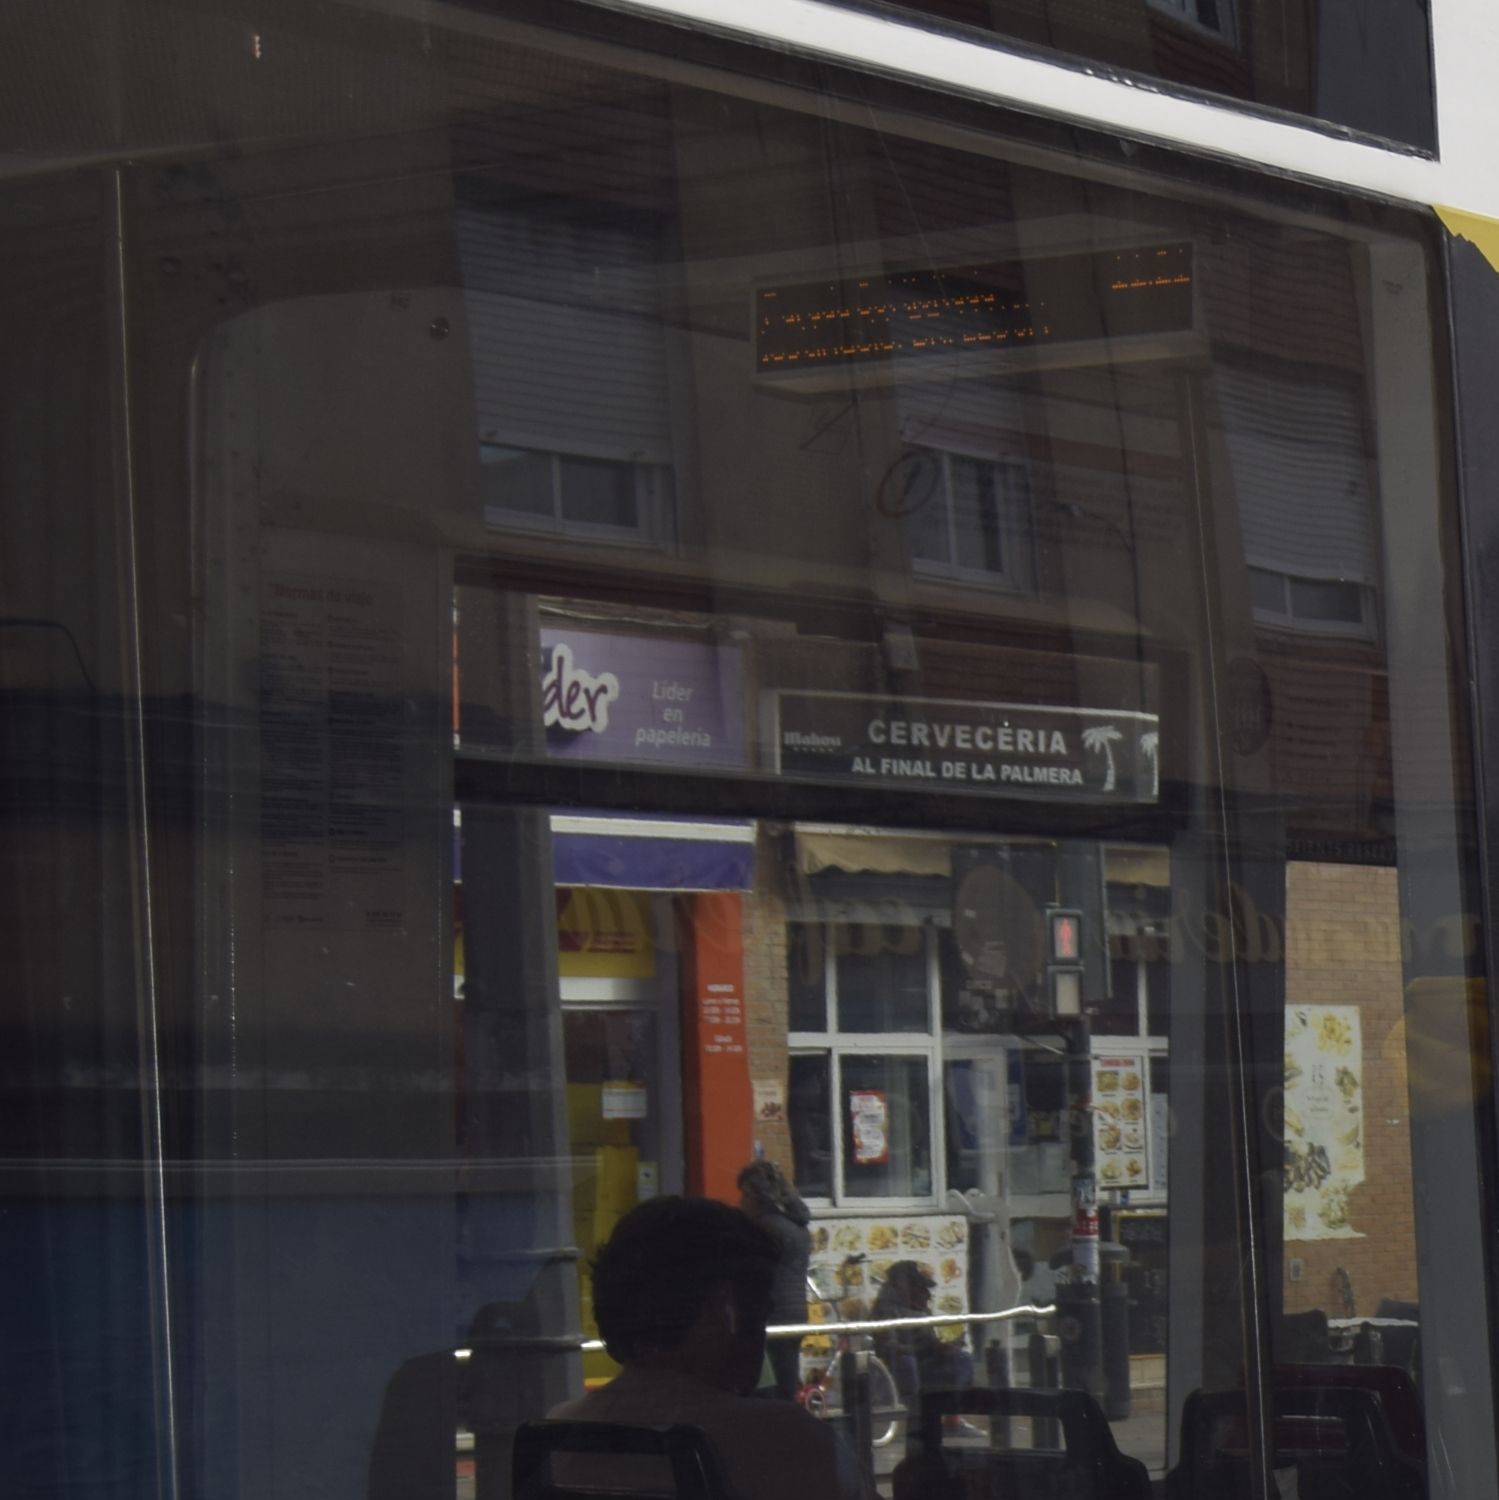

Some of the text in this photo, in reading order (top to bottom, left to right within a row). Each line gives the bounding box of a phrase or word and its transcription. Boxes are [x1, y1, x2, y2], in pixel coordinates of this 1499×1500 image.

[663, 707, 683, 724] en
[850, 756, 1084, 785] AL FINAL DE LA PALMERA
